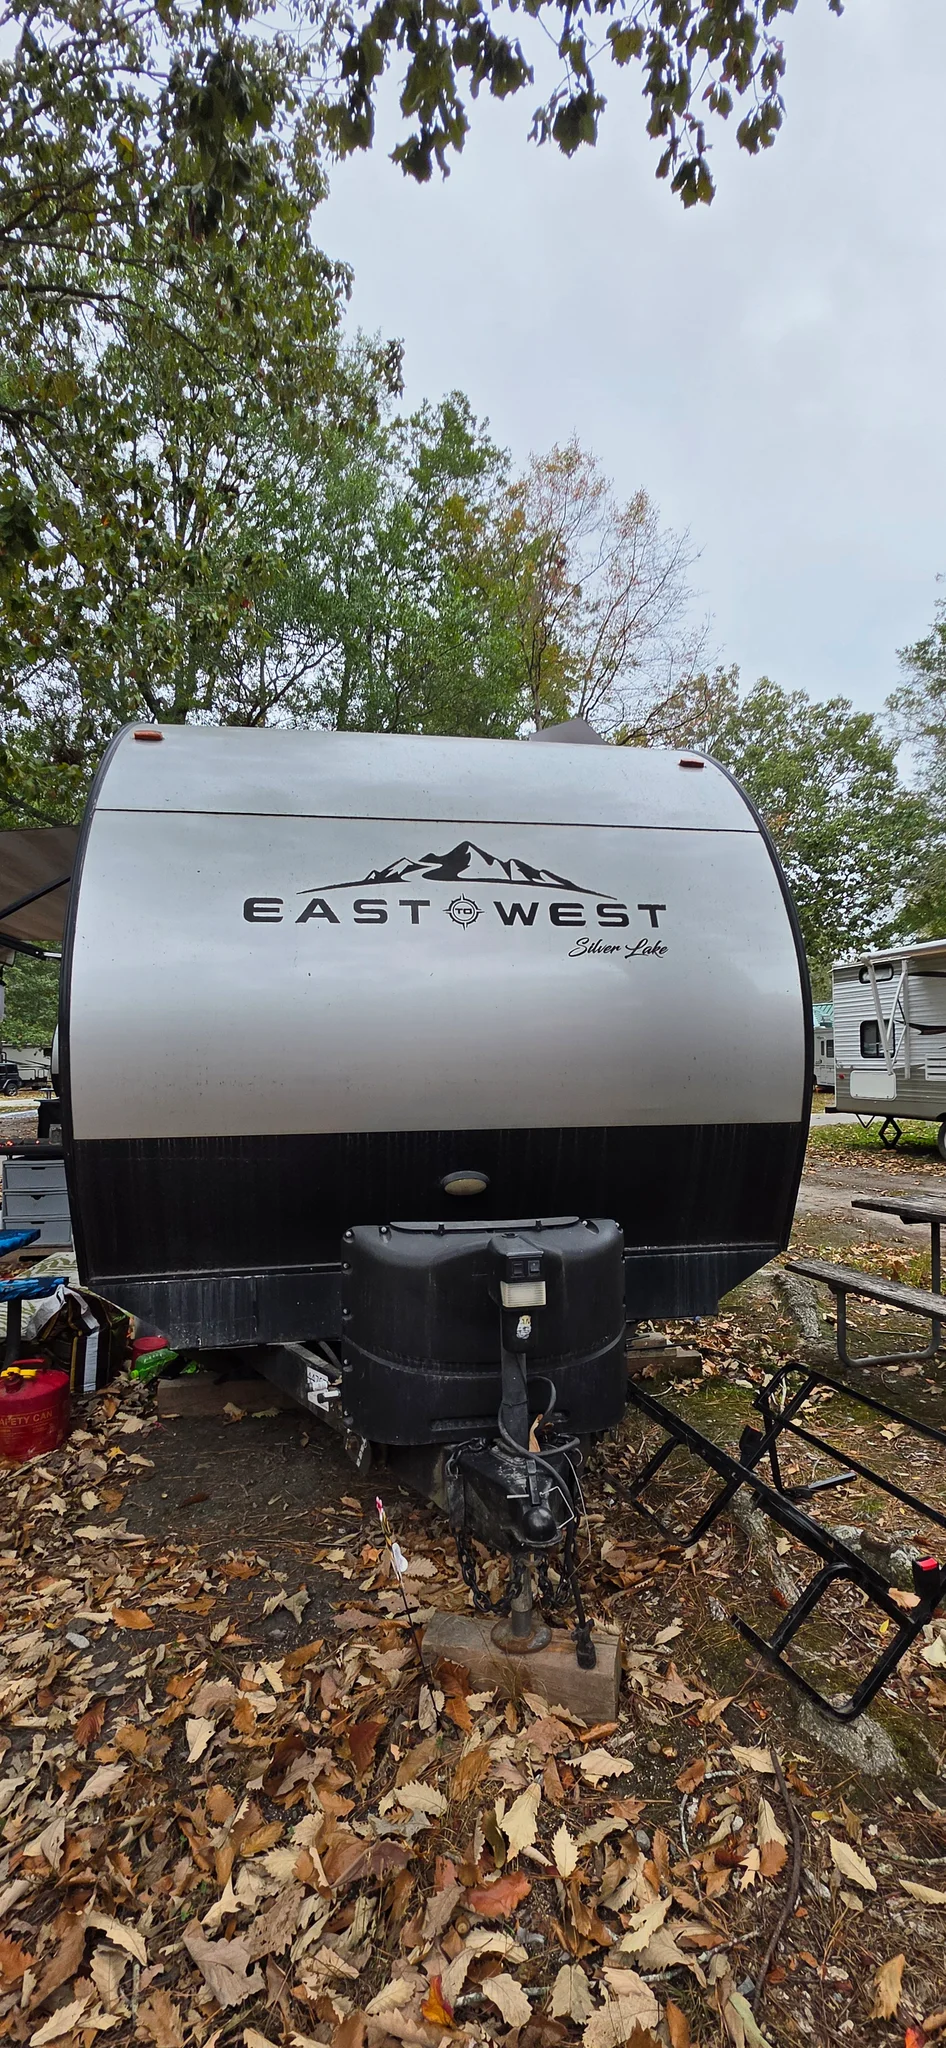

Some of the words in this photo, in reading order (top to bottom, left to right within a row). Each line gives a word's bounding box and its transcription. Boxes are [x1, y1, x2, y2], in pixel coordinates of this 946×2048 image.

[243, 897, 430, 925] EAST
[454, 907, 473, 915] TO
[494, 901, 667, 928] WEST
[568, 937, 621, 957] Silver
[624, 938, 669, 959] Lake
[32, 1410, 53, 1422] CAN
